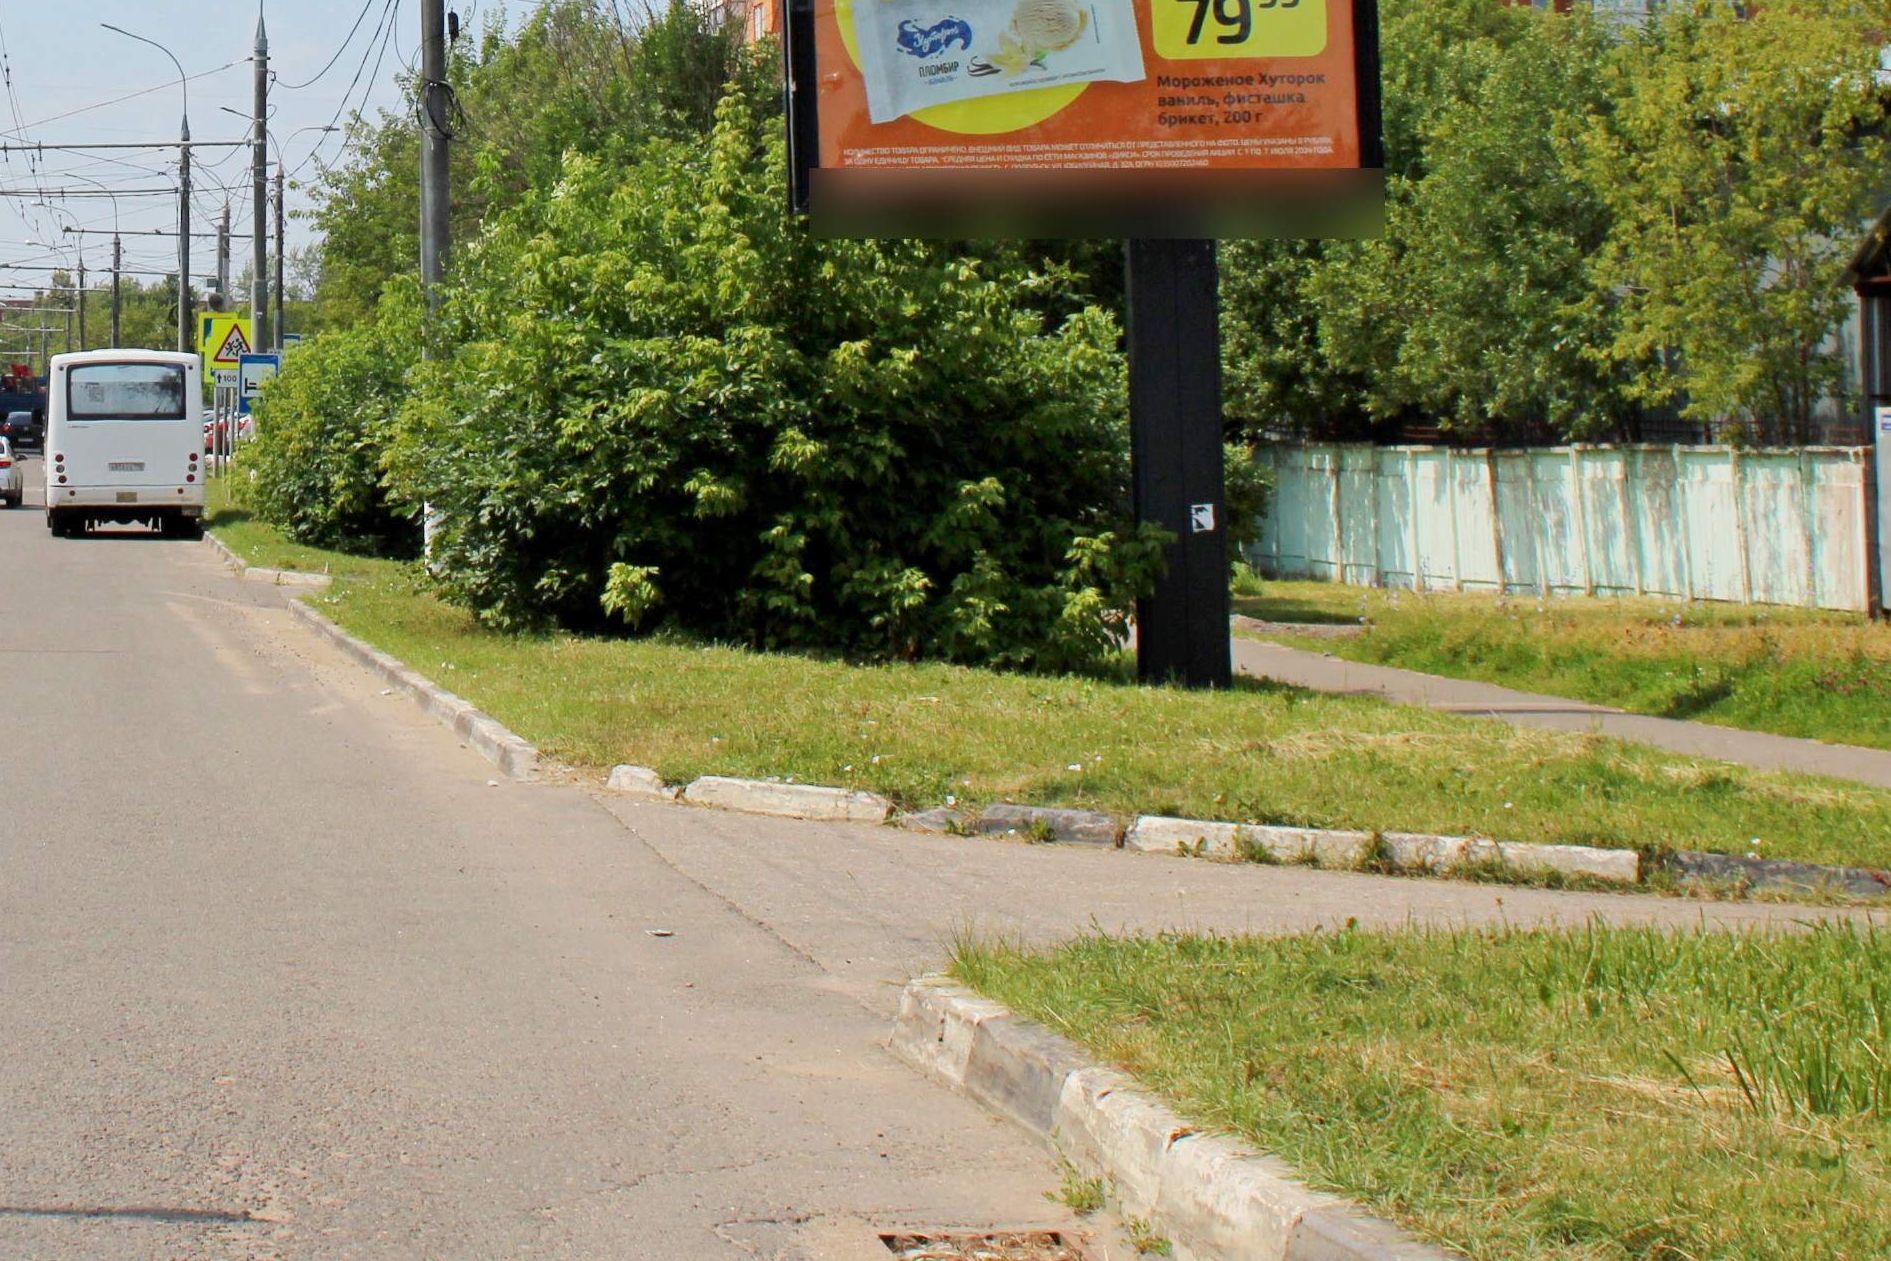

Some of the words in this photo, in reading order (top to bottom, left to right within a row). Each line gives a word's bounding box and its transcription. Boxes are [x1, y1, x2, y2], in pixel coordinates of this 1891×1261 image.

[918, 60, 959, 78] ПЛОМБИР
[1156, 74, 1255, 90] Мороженое
[1258, 72, 1326, 88] Хуторок
[1157, 94, 1220, 108] ваниль,
[1222, 91, 1306, 108] фисташка
[1157, 111, 1220, 128] брикет,
[1223, 111, 1252, 125] 200
[1255, 112, 1264, 124] г
[222, 372, 238, 383] 100
